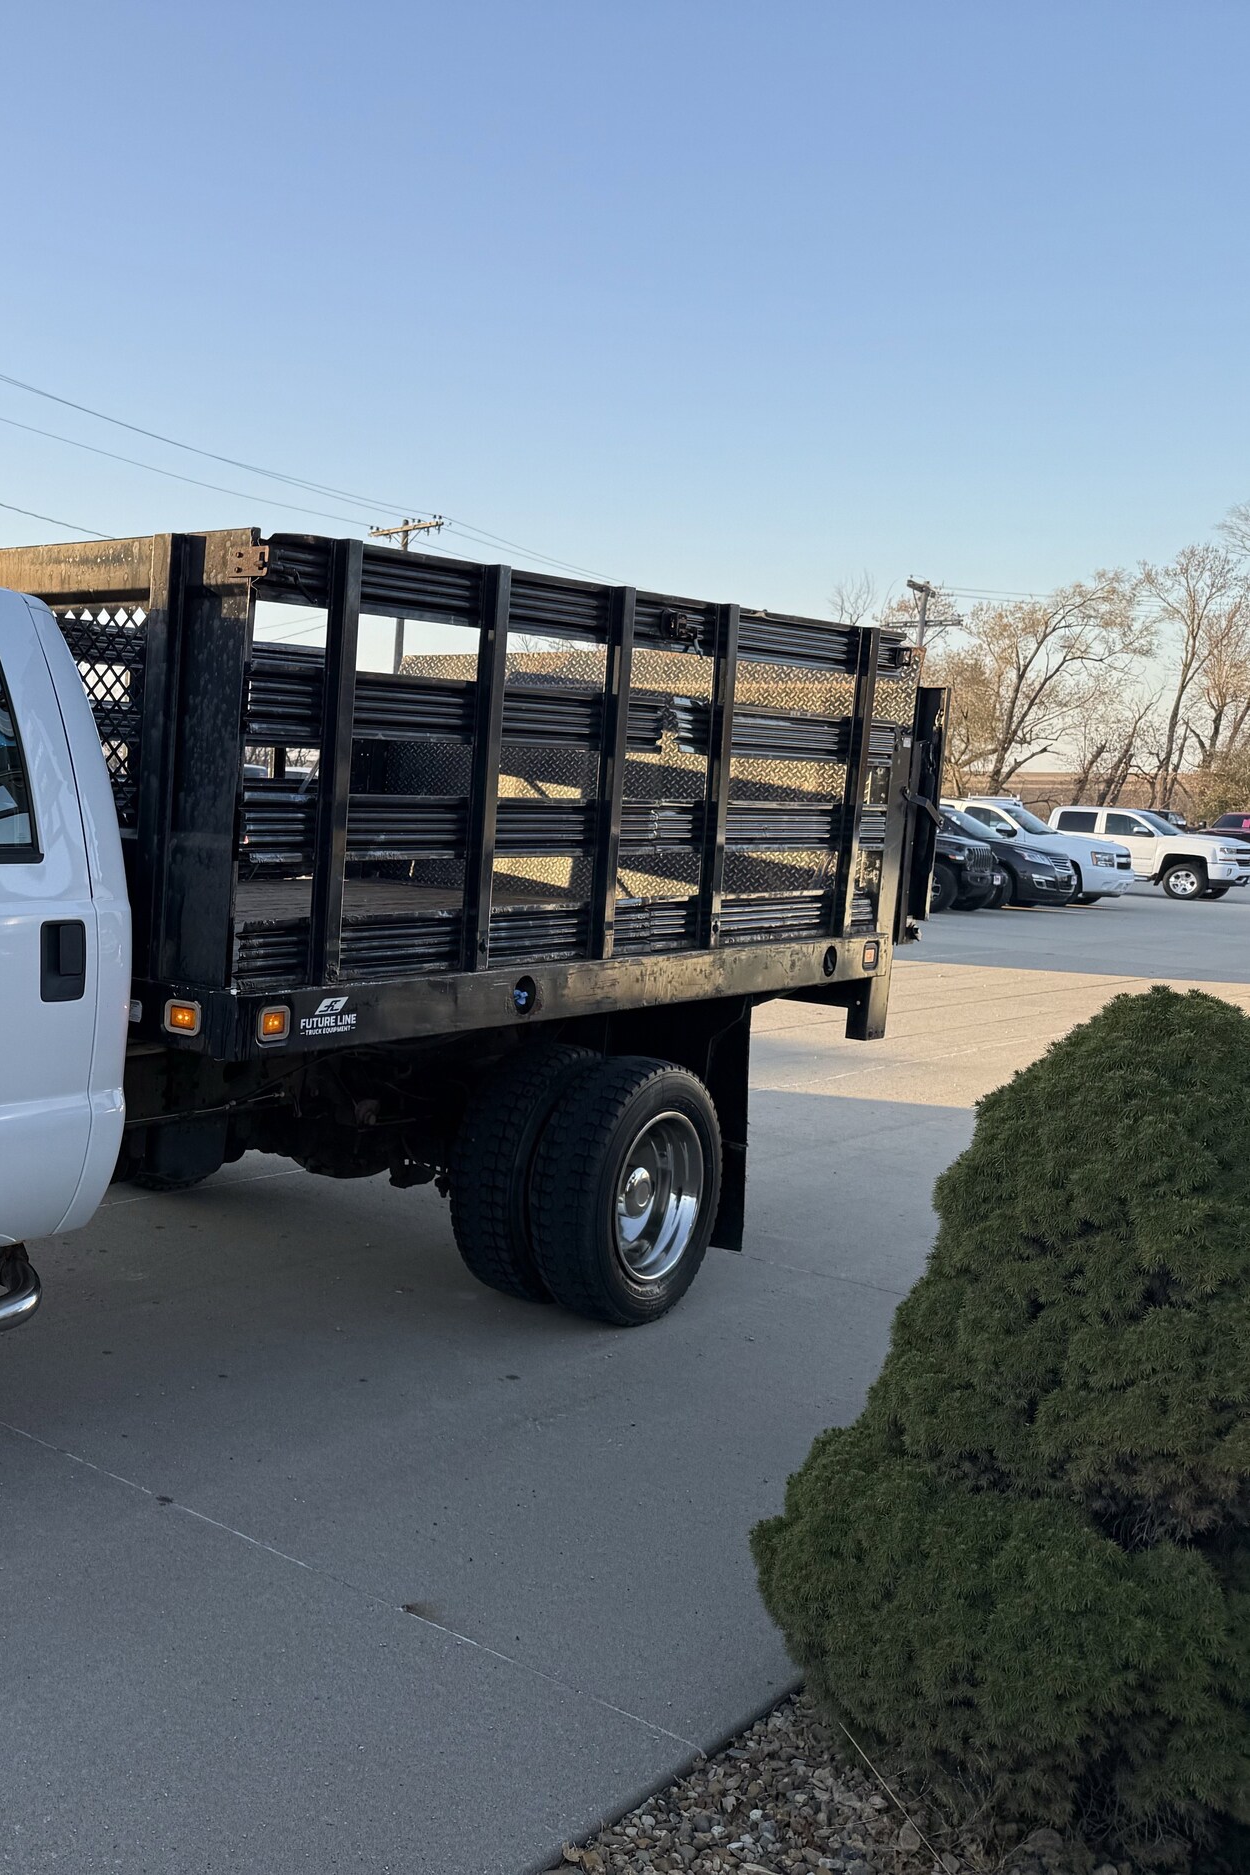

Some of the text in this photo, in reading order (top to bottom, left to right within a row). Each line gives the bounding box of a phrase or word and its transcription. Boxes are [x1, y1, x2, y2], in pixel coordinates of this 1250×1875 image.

[300, 1013, 357, 1030] FUTURE LINE
[305, 1025, 351, 1036] TRUCK EQUIPMENT
